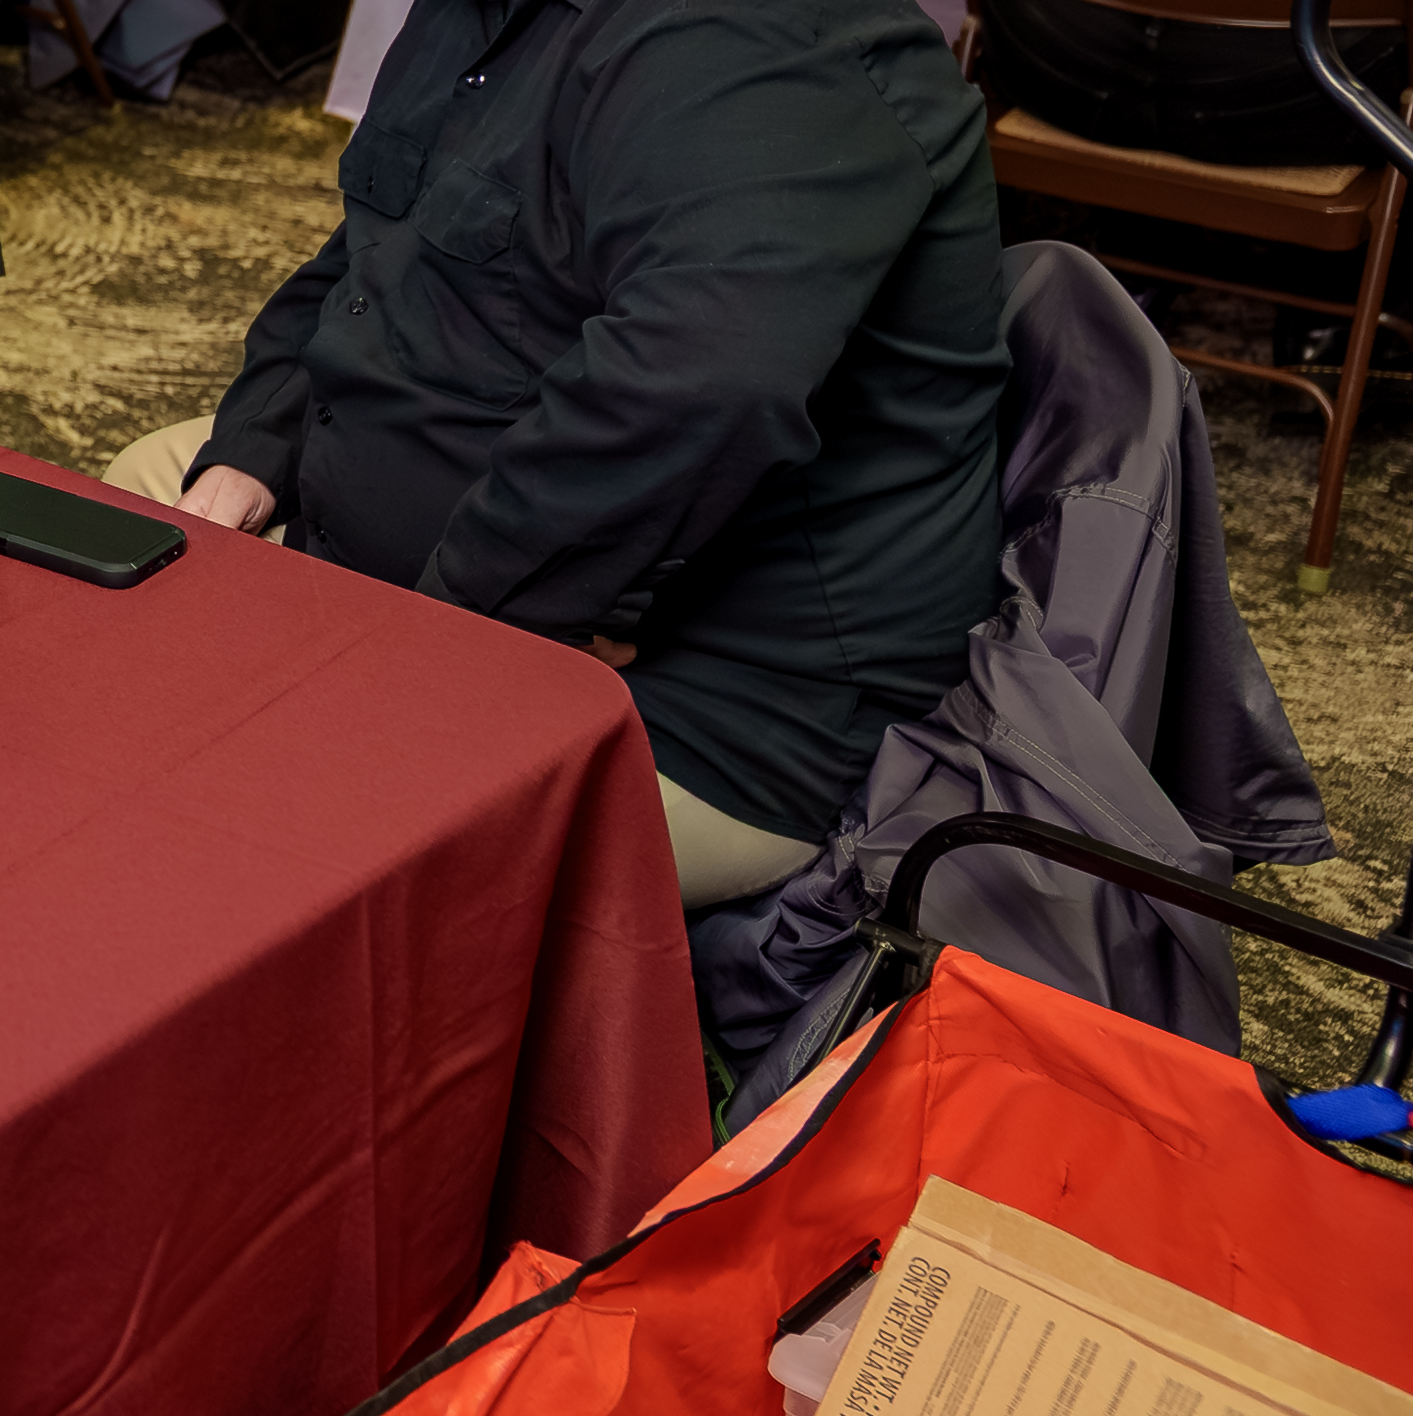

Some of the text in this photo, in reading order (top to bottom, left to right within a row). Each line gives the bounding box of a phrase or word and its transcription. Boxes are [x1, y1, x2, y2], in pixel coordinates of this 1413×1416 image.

[844, 1256, 931, 1412] CONT. NET. DE LA MASA
[873, 1267, 950, 1404] COMPOUND NET WT.
